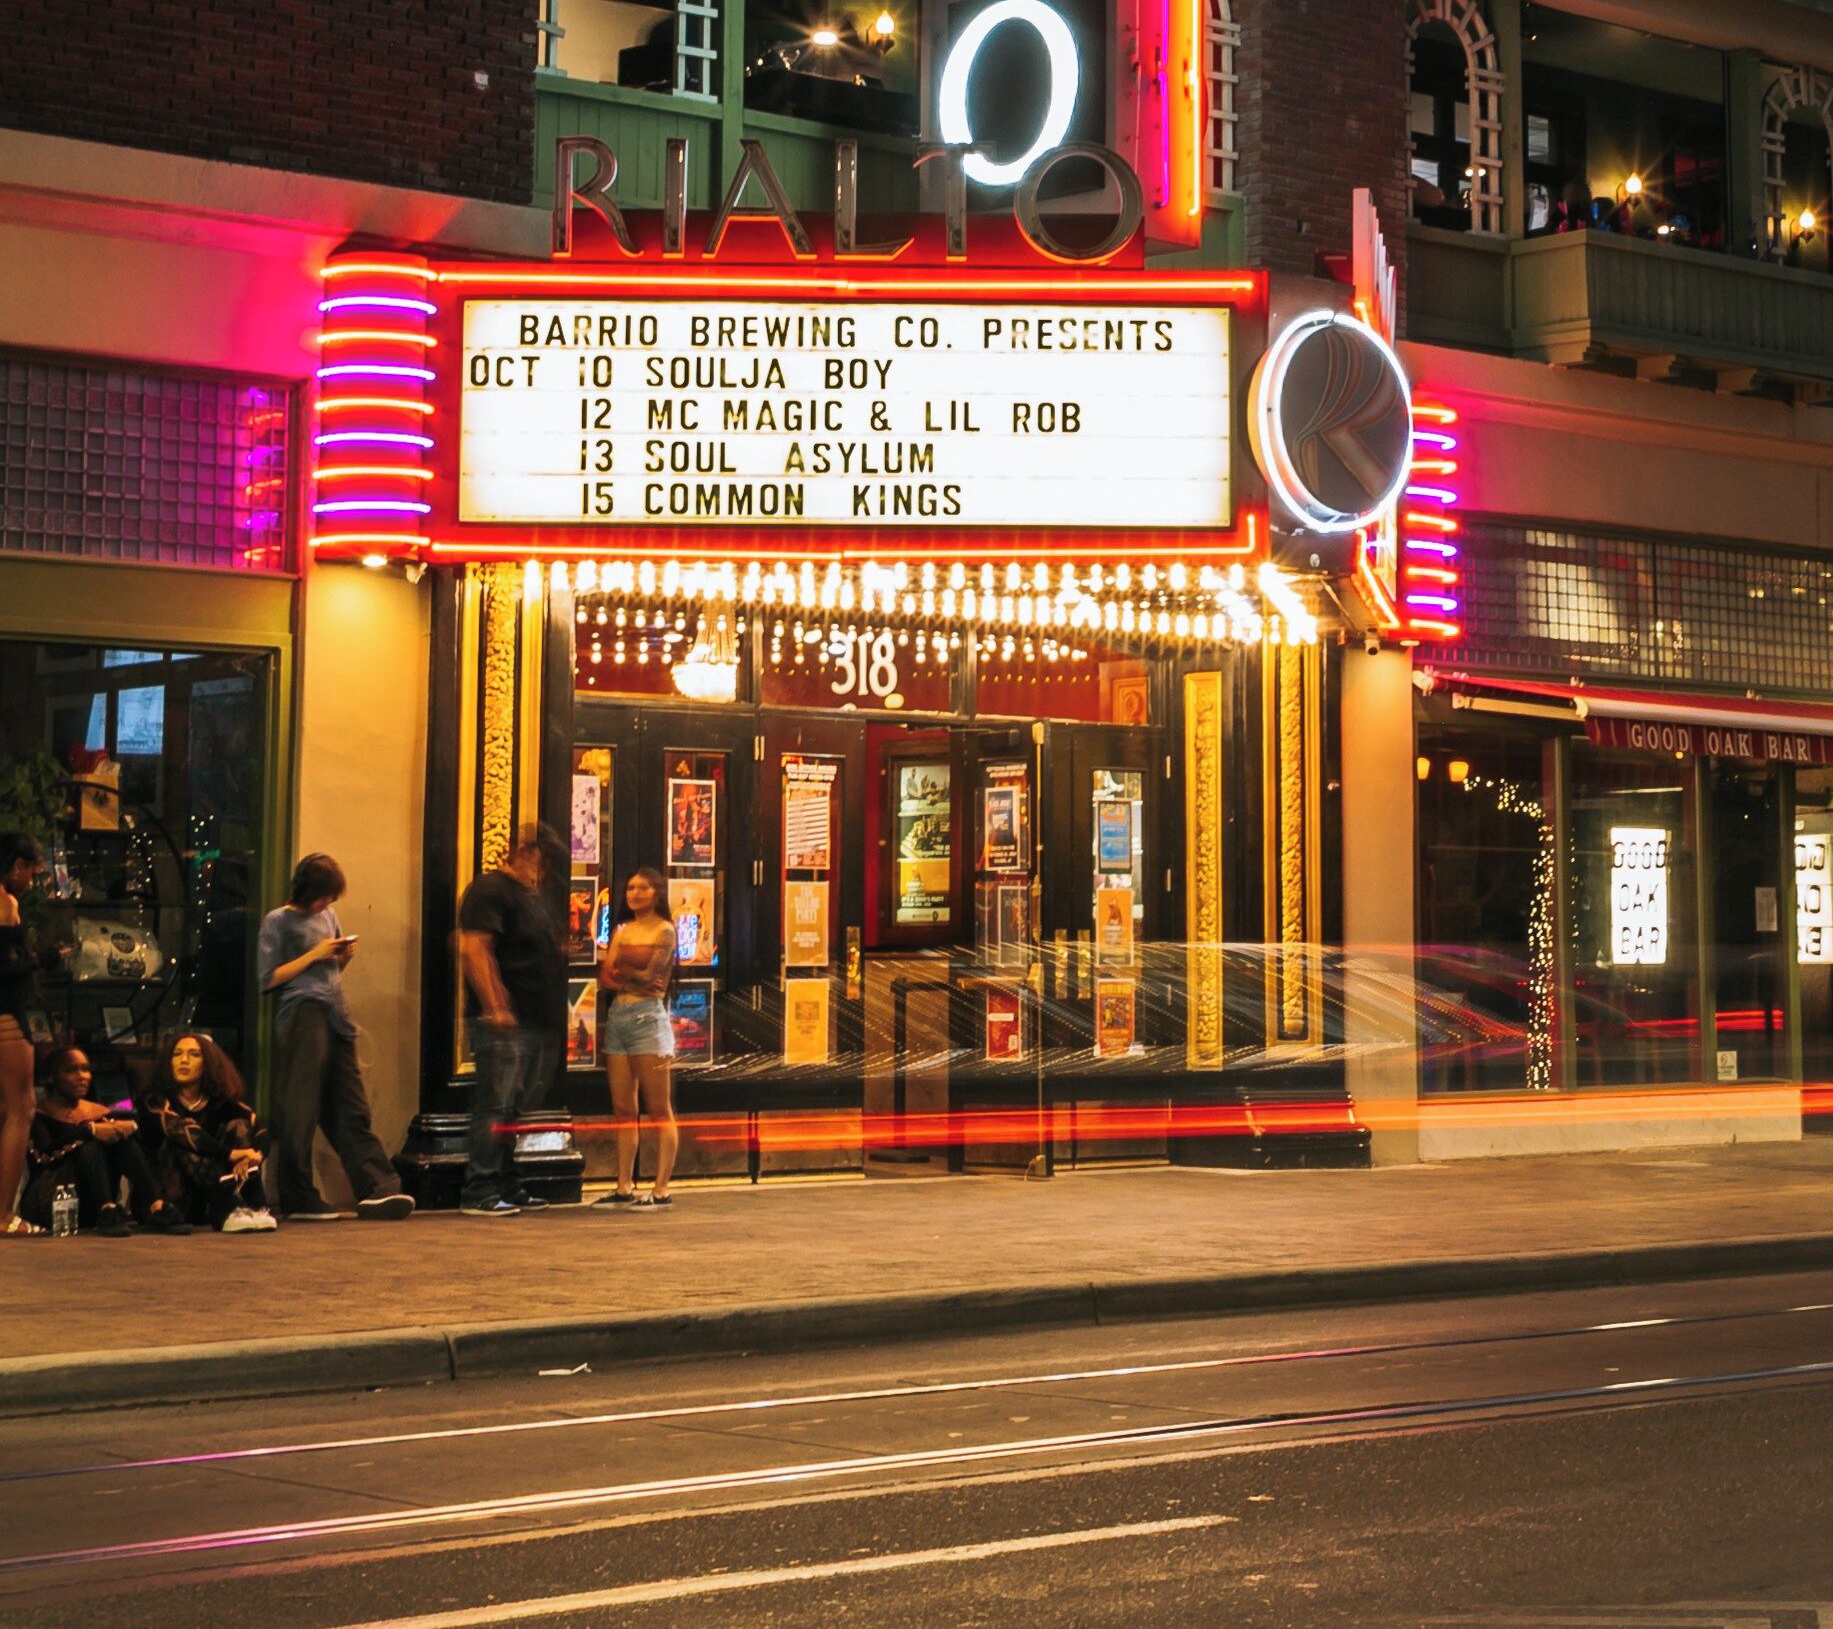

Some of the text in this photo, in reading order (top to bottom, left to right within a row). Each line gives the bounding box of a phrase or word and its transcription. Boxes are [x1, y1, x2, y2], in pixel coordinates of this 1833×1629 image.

[553, 138, 1144, 265] RIALTO
[519, 314, 1174, 351] BARRIO BREWING CO. PRESENTS
[469, 354, 893, 390] OCT 10 SOULJA BOY
[580, 398, 1081, 433] 12 MC MAGIC & LIL ROB
[580, 439, 935, 474] 13 SOUL ASYLUM
[582, 482, 962, 516] 15 COMMON KINGS
[831, 630, 898, 697] 318
[1631, 724, 1809, 761] GOOD OAK BAR
[1613, 840, 1667, 869] GOOD
[1619, 883, 1659, 912] OAK
[1621, 926, 1660, 955] BAR
